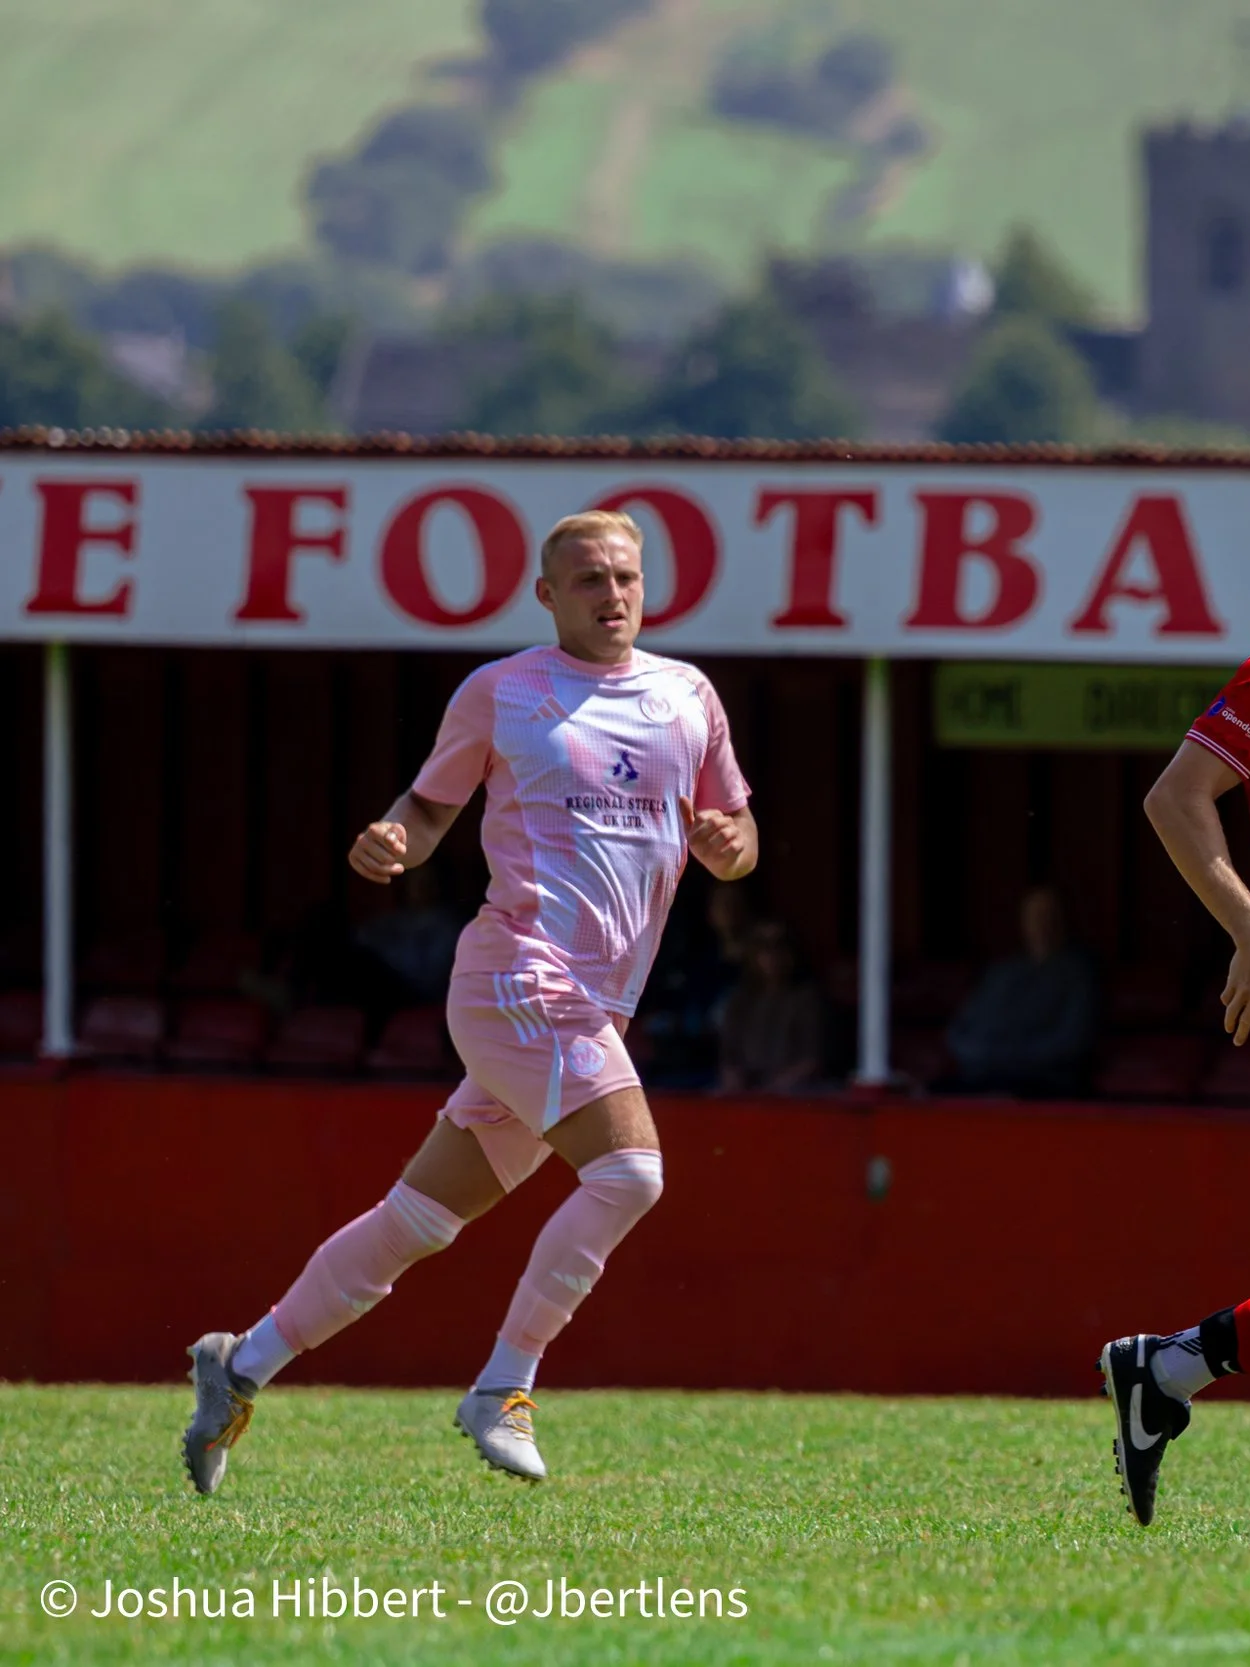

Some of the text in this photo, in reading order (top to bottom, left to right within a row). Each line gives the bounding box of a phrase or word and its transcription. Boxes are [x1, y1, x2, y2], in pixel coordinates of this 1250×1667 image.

[0, 480, 138, 618] E
[565, 796, 668, 813] REGIONAL STEELS
[603, 814, 645, 828] UK LTD.
